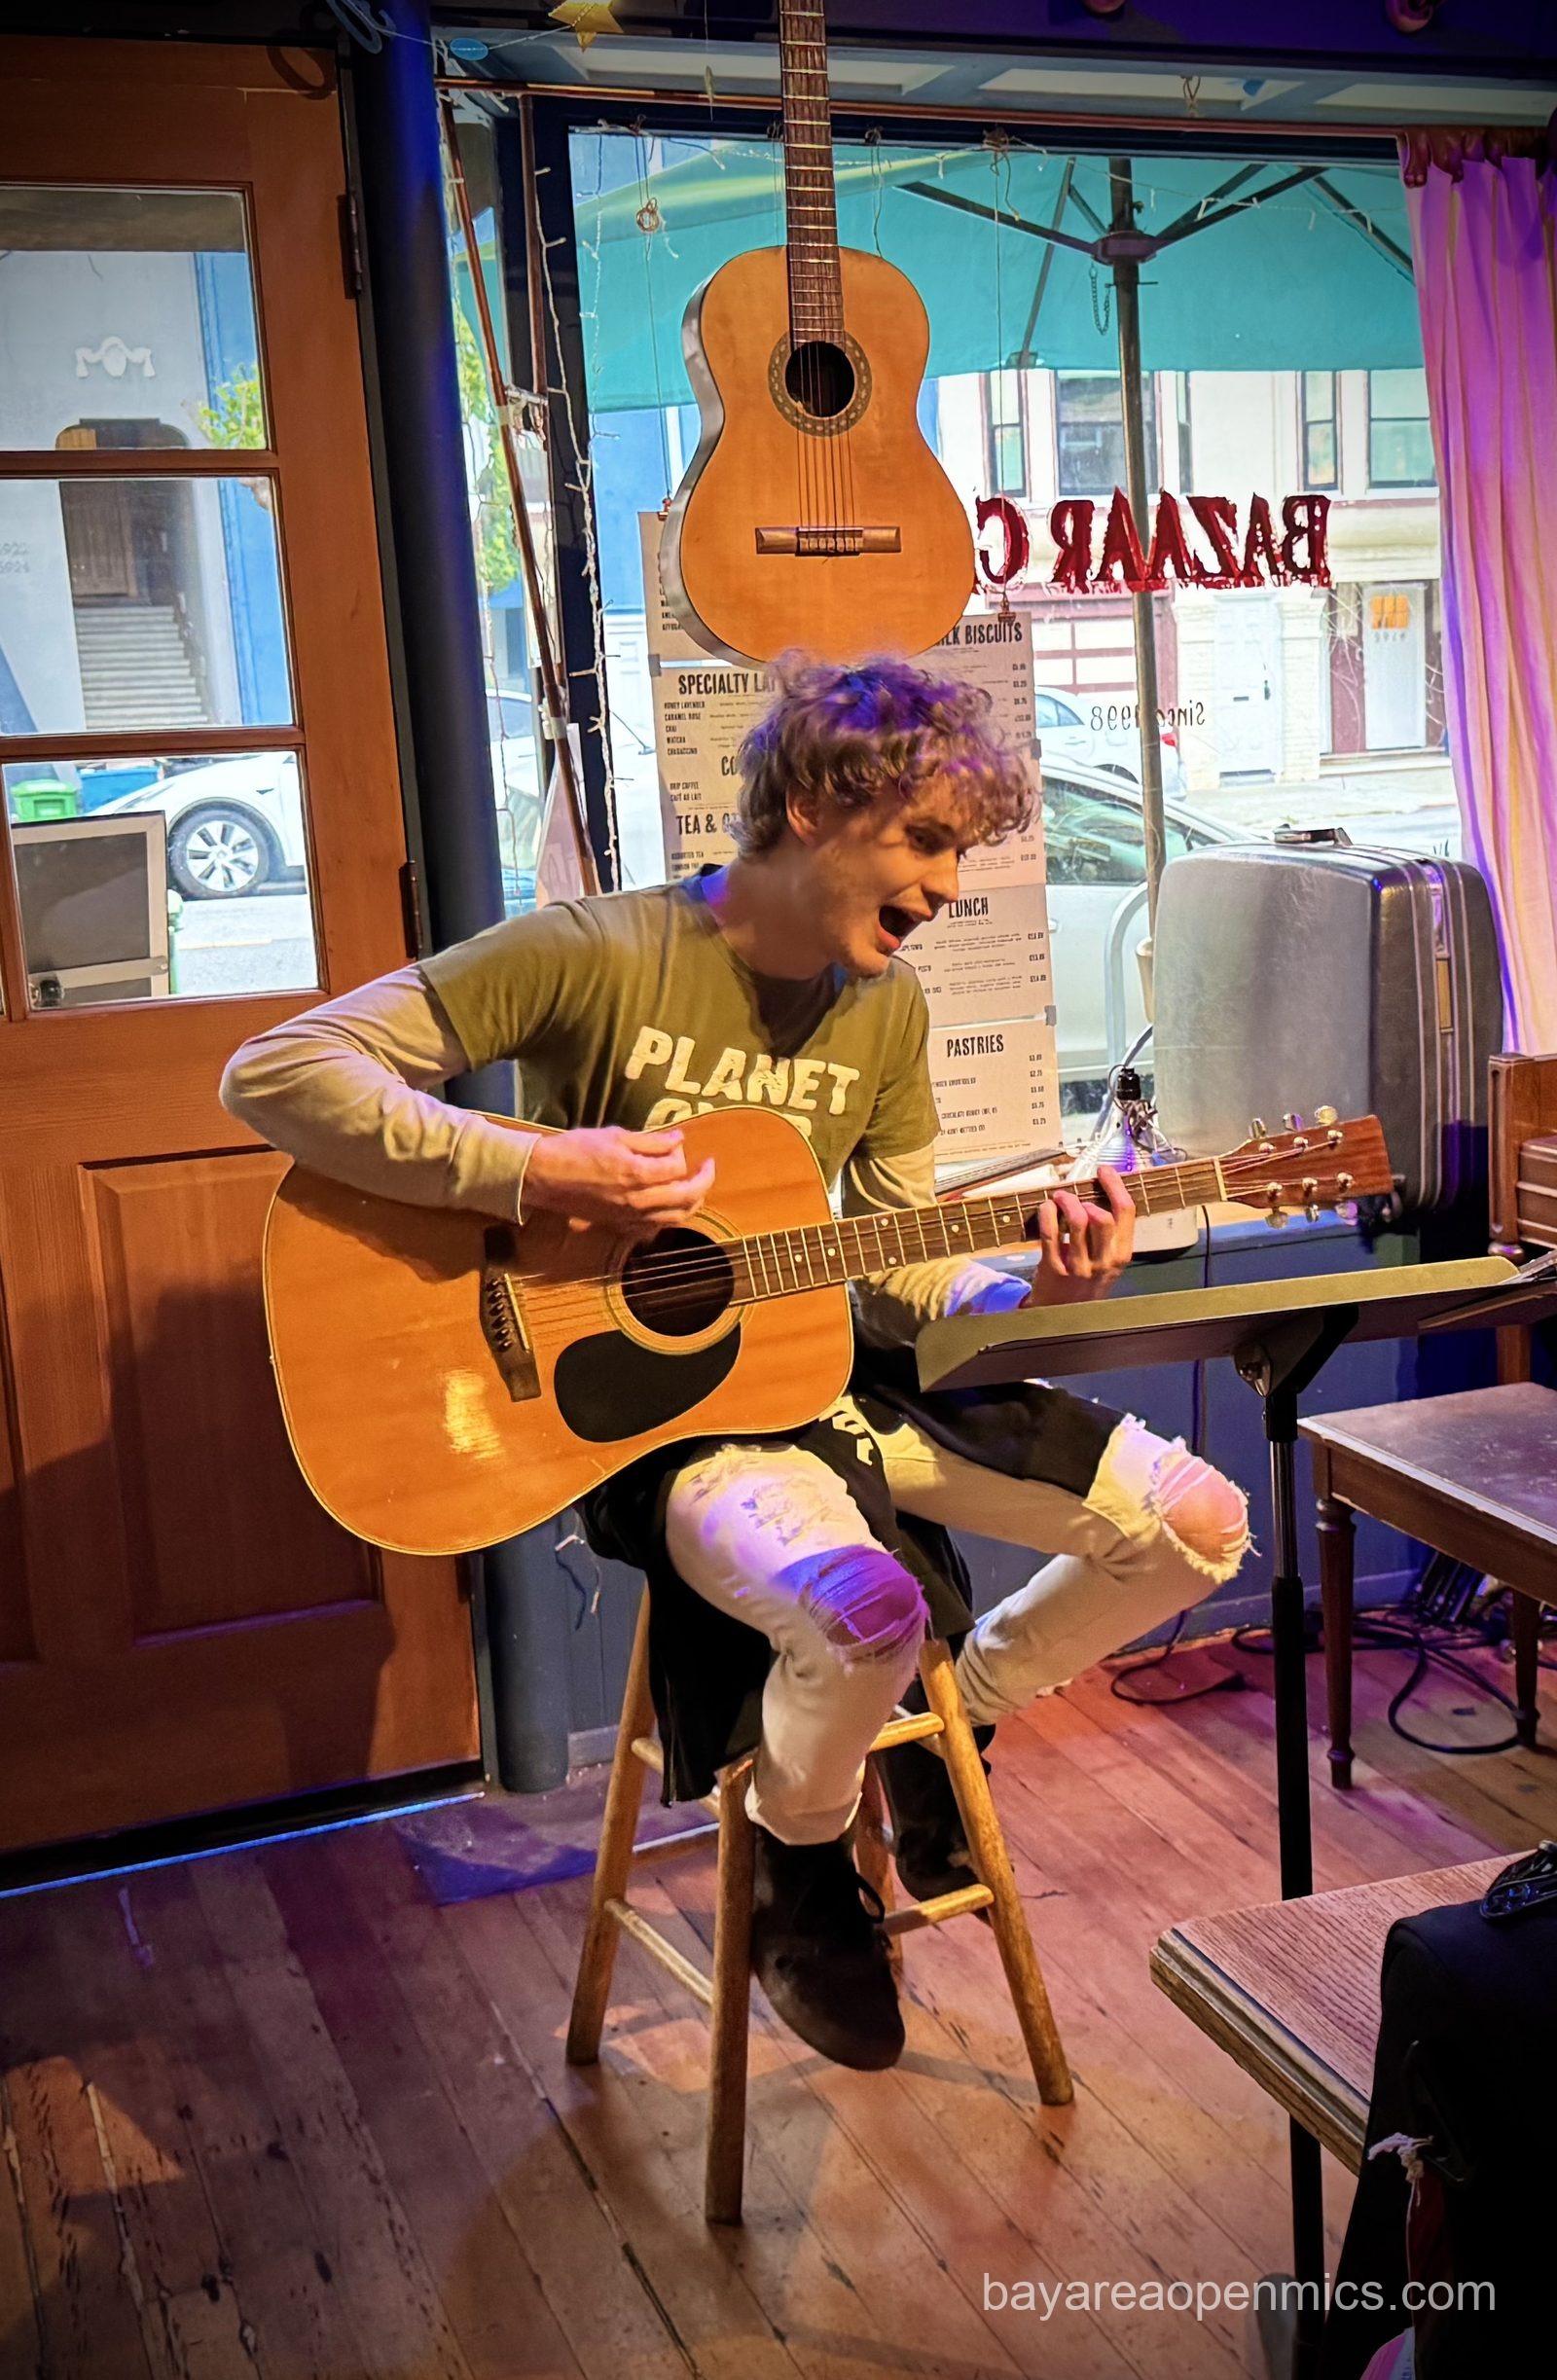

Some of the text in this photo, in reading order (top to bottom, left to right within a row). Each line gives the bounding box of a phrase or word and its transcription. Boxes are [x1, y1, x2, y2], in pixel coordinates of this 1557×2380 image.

[965, 622, 1023, 645] BISCUITS
[678, 672, 749, 696] SPECIALTY
[676, 814, 701, 836] TEA
[706, 813, 717, 833] &
[948, 896, 989, 920] LUNCH
[947, 1033, 1004, 1059] PASTRIES
[624, 1025, 860, 1115] PLANET
